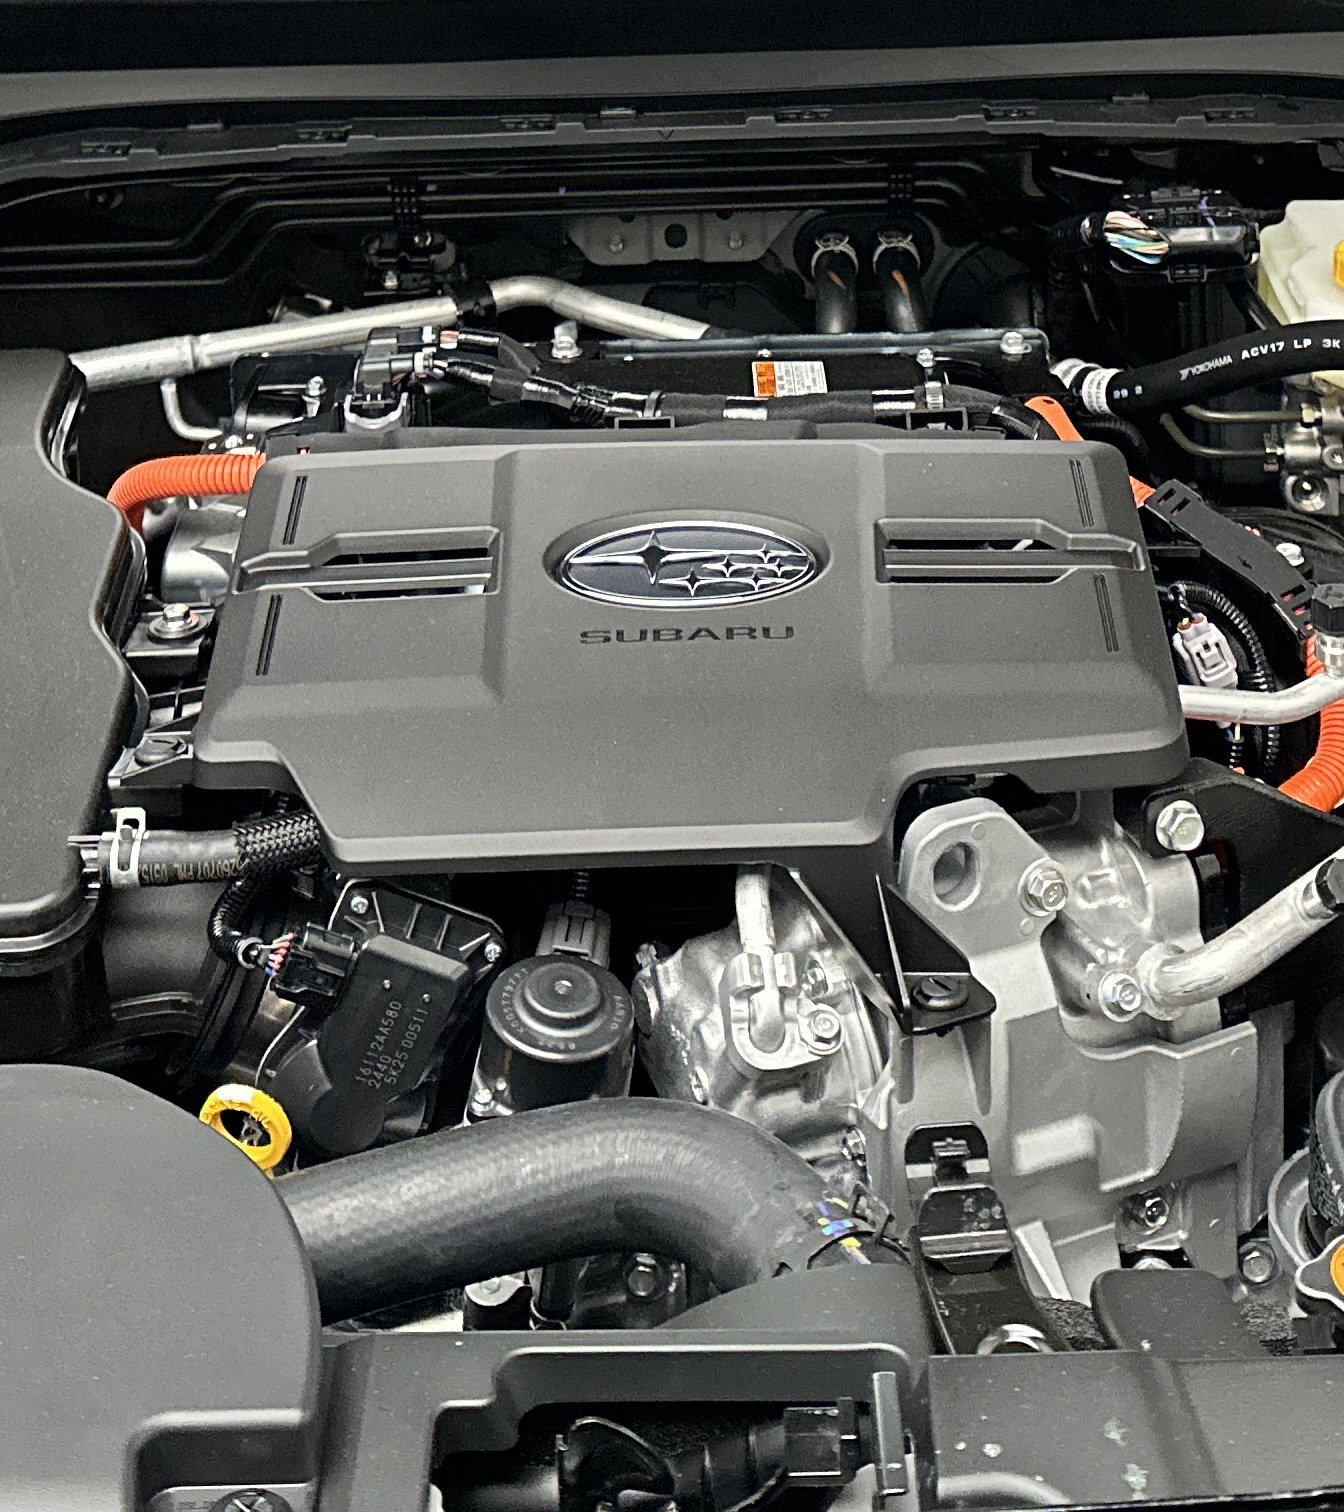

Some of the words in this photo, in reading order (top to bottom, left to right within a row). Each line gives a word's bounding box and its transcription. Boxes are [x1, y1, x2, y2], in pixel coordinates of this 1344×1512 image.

[1241, 341, 1285, 360] ACV17
[1293, 338, 1312, 349] LP
[579, 625, 795, 645] SUBARU
[355, 1000, 402, 1082] 16112AA580
[401, 1008, 429, 1049] 00511
